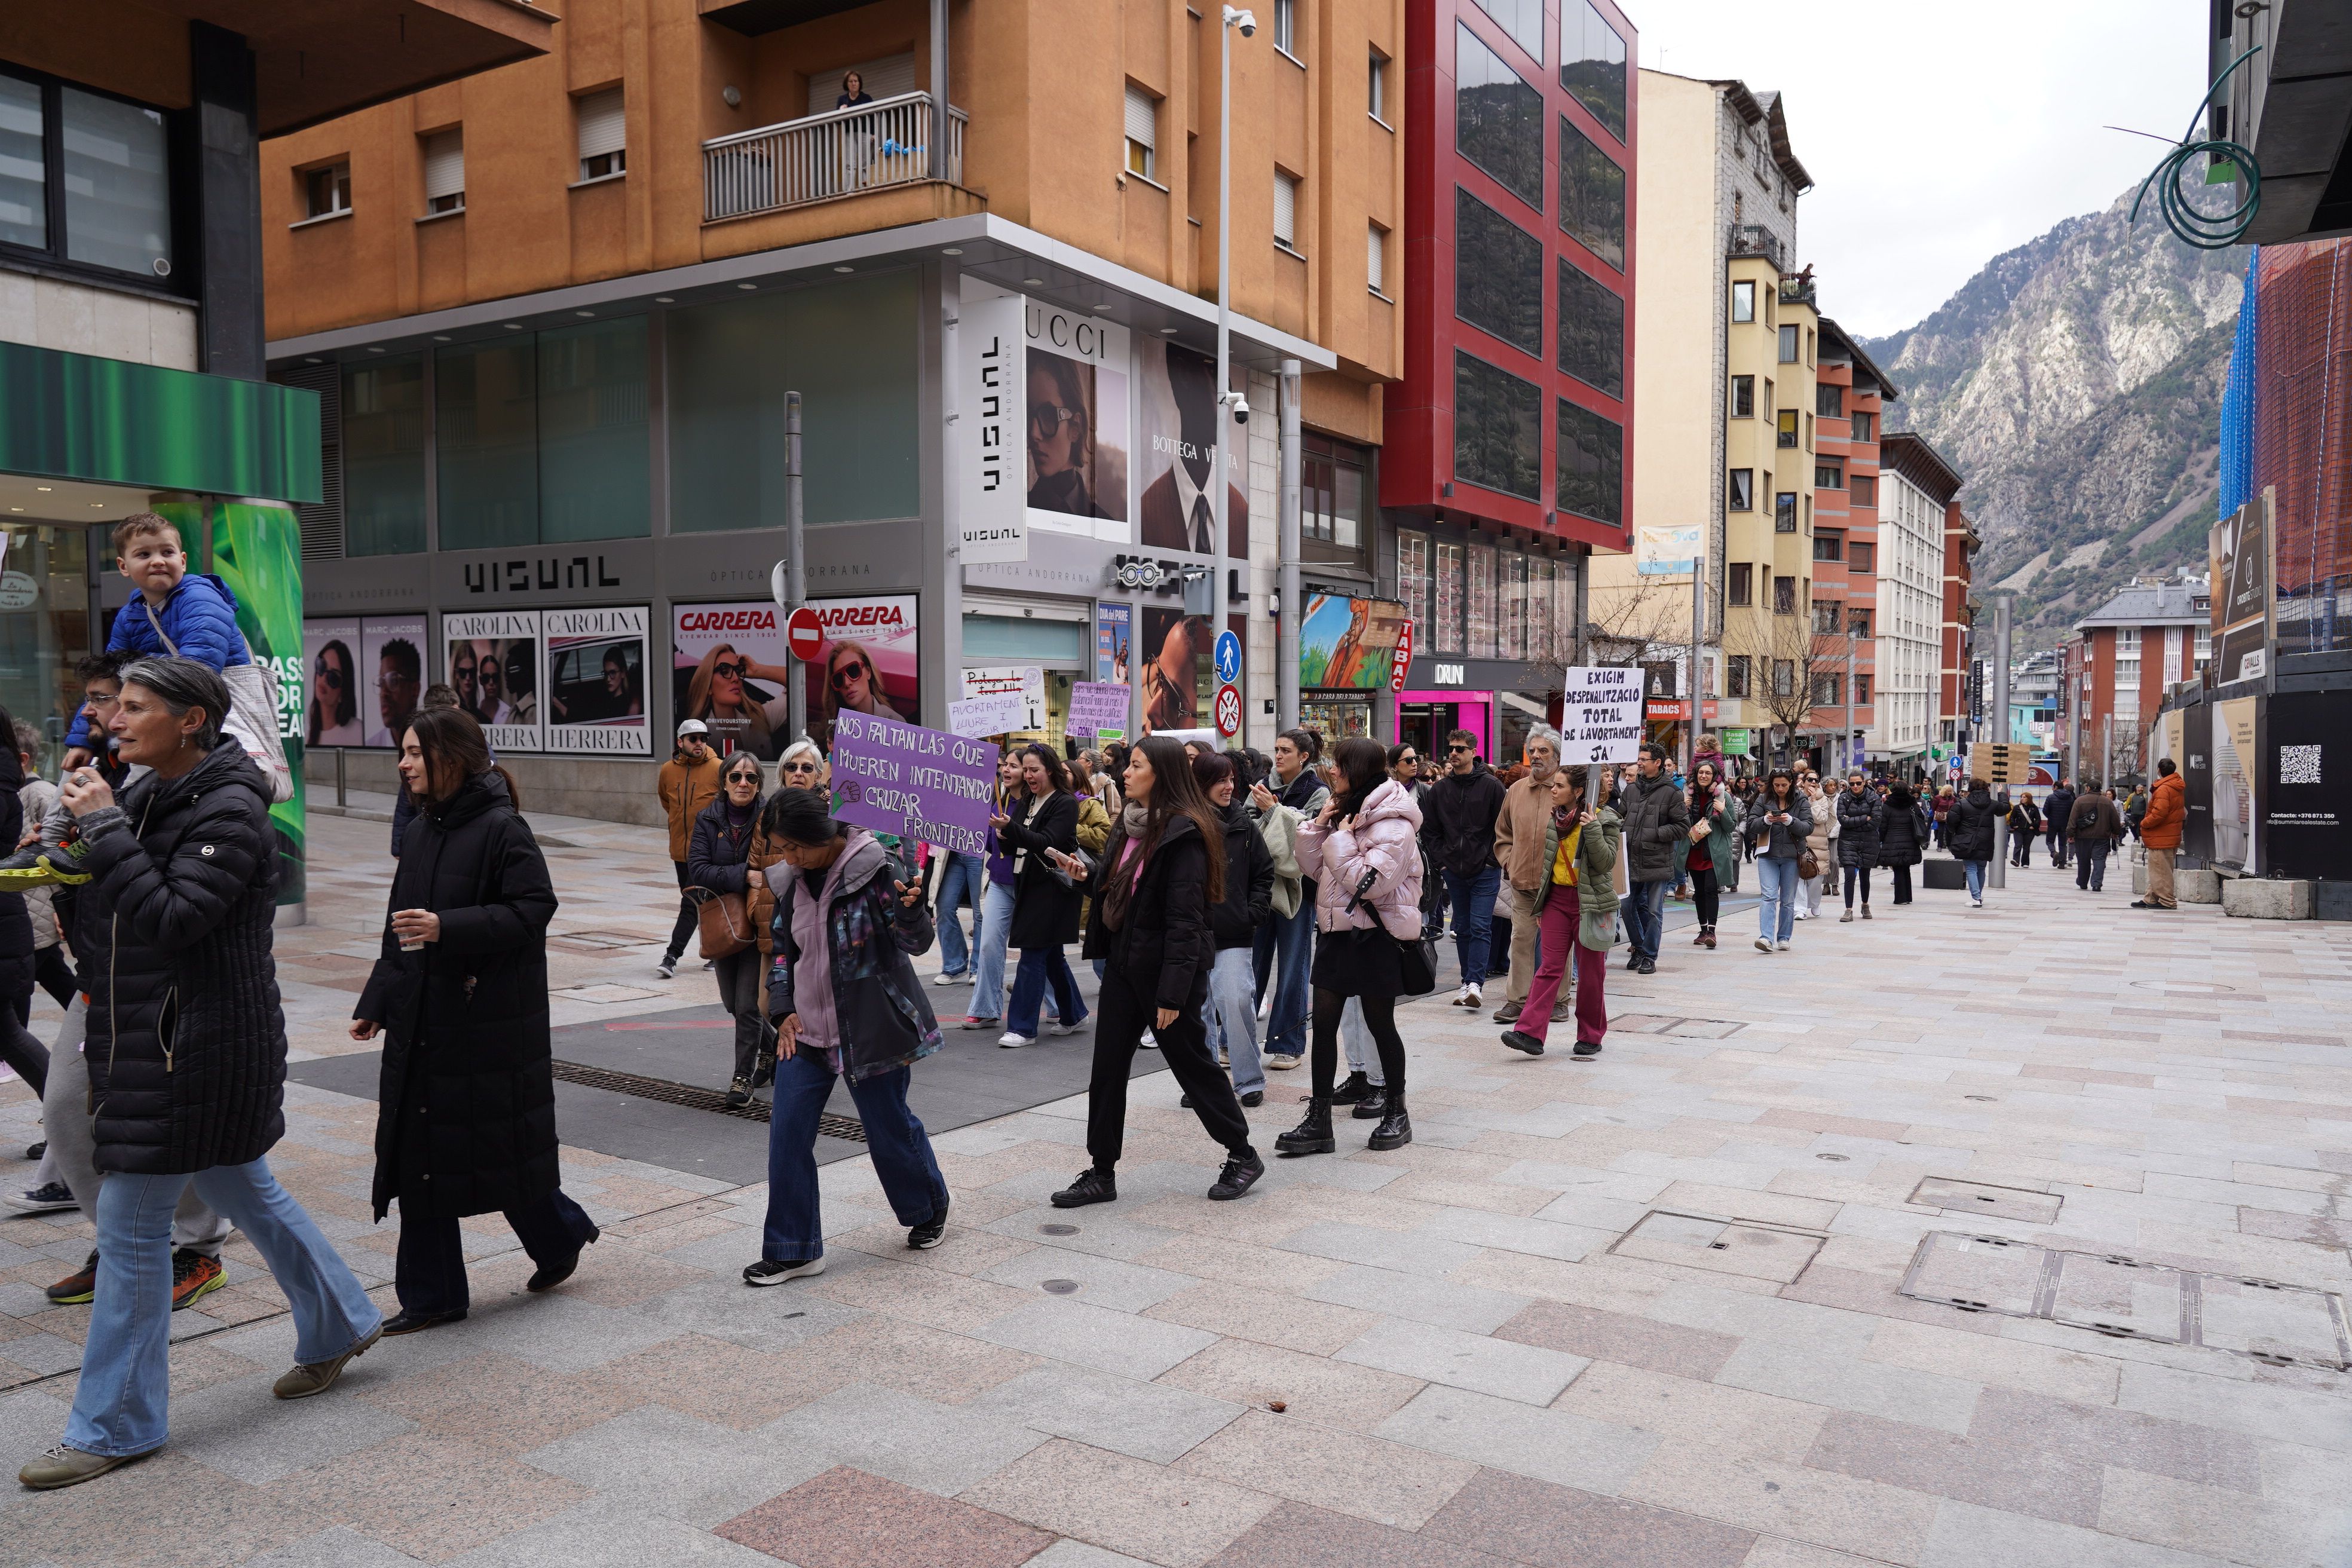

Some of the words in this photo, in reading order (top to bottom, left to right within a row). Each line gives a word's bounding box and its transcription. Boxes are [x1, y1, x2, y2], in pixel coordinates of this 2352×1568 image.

[1025, 305, 1104, 359] UCCI
[982, 336, 999, 491] VISUAL
[1153, 434, 1198, 460] BOTTEGA
[1205, 448, 1238, 469] VETA
[964, 528, 1020, 541] VISUAL
[465, 556, 620, 593] VISUAL
[808, 565, 869, 577] ORRANA
[1028, 569, 1090, 583] ANDORRANA
[2250, 585, 2262, 599] STUDIO
[549, 611, 642, 633] CAROLINA
[680, 611, 776, 631] CARRERA
[812, 605, 903, 627] ARRERA
[1115, 610, 1128, 621] PARE
[326, 627, 358, 636] JACOBS
[390, 625, 423, 633] JACOBS
[449, 616, 535, 636] CAROLINA
[1392, 622, 1411, 690] TABAC
[1434, 664, 1463, 685] DRUNI
[1588, 671, 1624, 685] EXIGIM
[1025, 694, 1039, 705] teu
[1109, 687, 1120, 696] cosa
[1122, 688, 1129, 697] va
[1566, 682, 1640, 704] DESPENALITZACIÓ
[1023, 708, 1041, 730] L
[1583, 708, 1622, 723] TOTAL
[1647, 705, 1679, 714] TABACS
[551, 730, 645, 750] HERRERA
[837, 716, 862, 739] NOS
[866, 721, 917, 751] FALTAN
[918, 733, 945, 756] LAS
[952, 740, 985, 767] QUE
[967, 726, 999, 738] SEGUR
[1077, 727, 1092, 737] DONA
[1564, 728, 1575, 740] DE
[1590, 745, 1613, 762] JA!
[838, 747, 899, 782] MUEREN
[909, 765, 993, 804] INTENTANDO
[865, 786, 923, 818] CRUZAR
[903, 816, 986, 855] FRONTERAS
